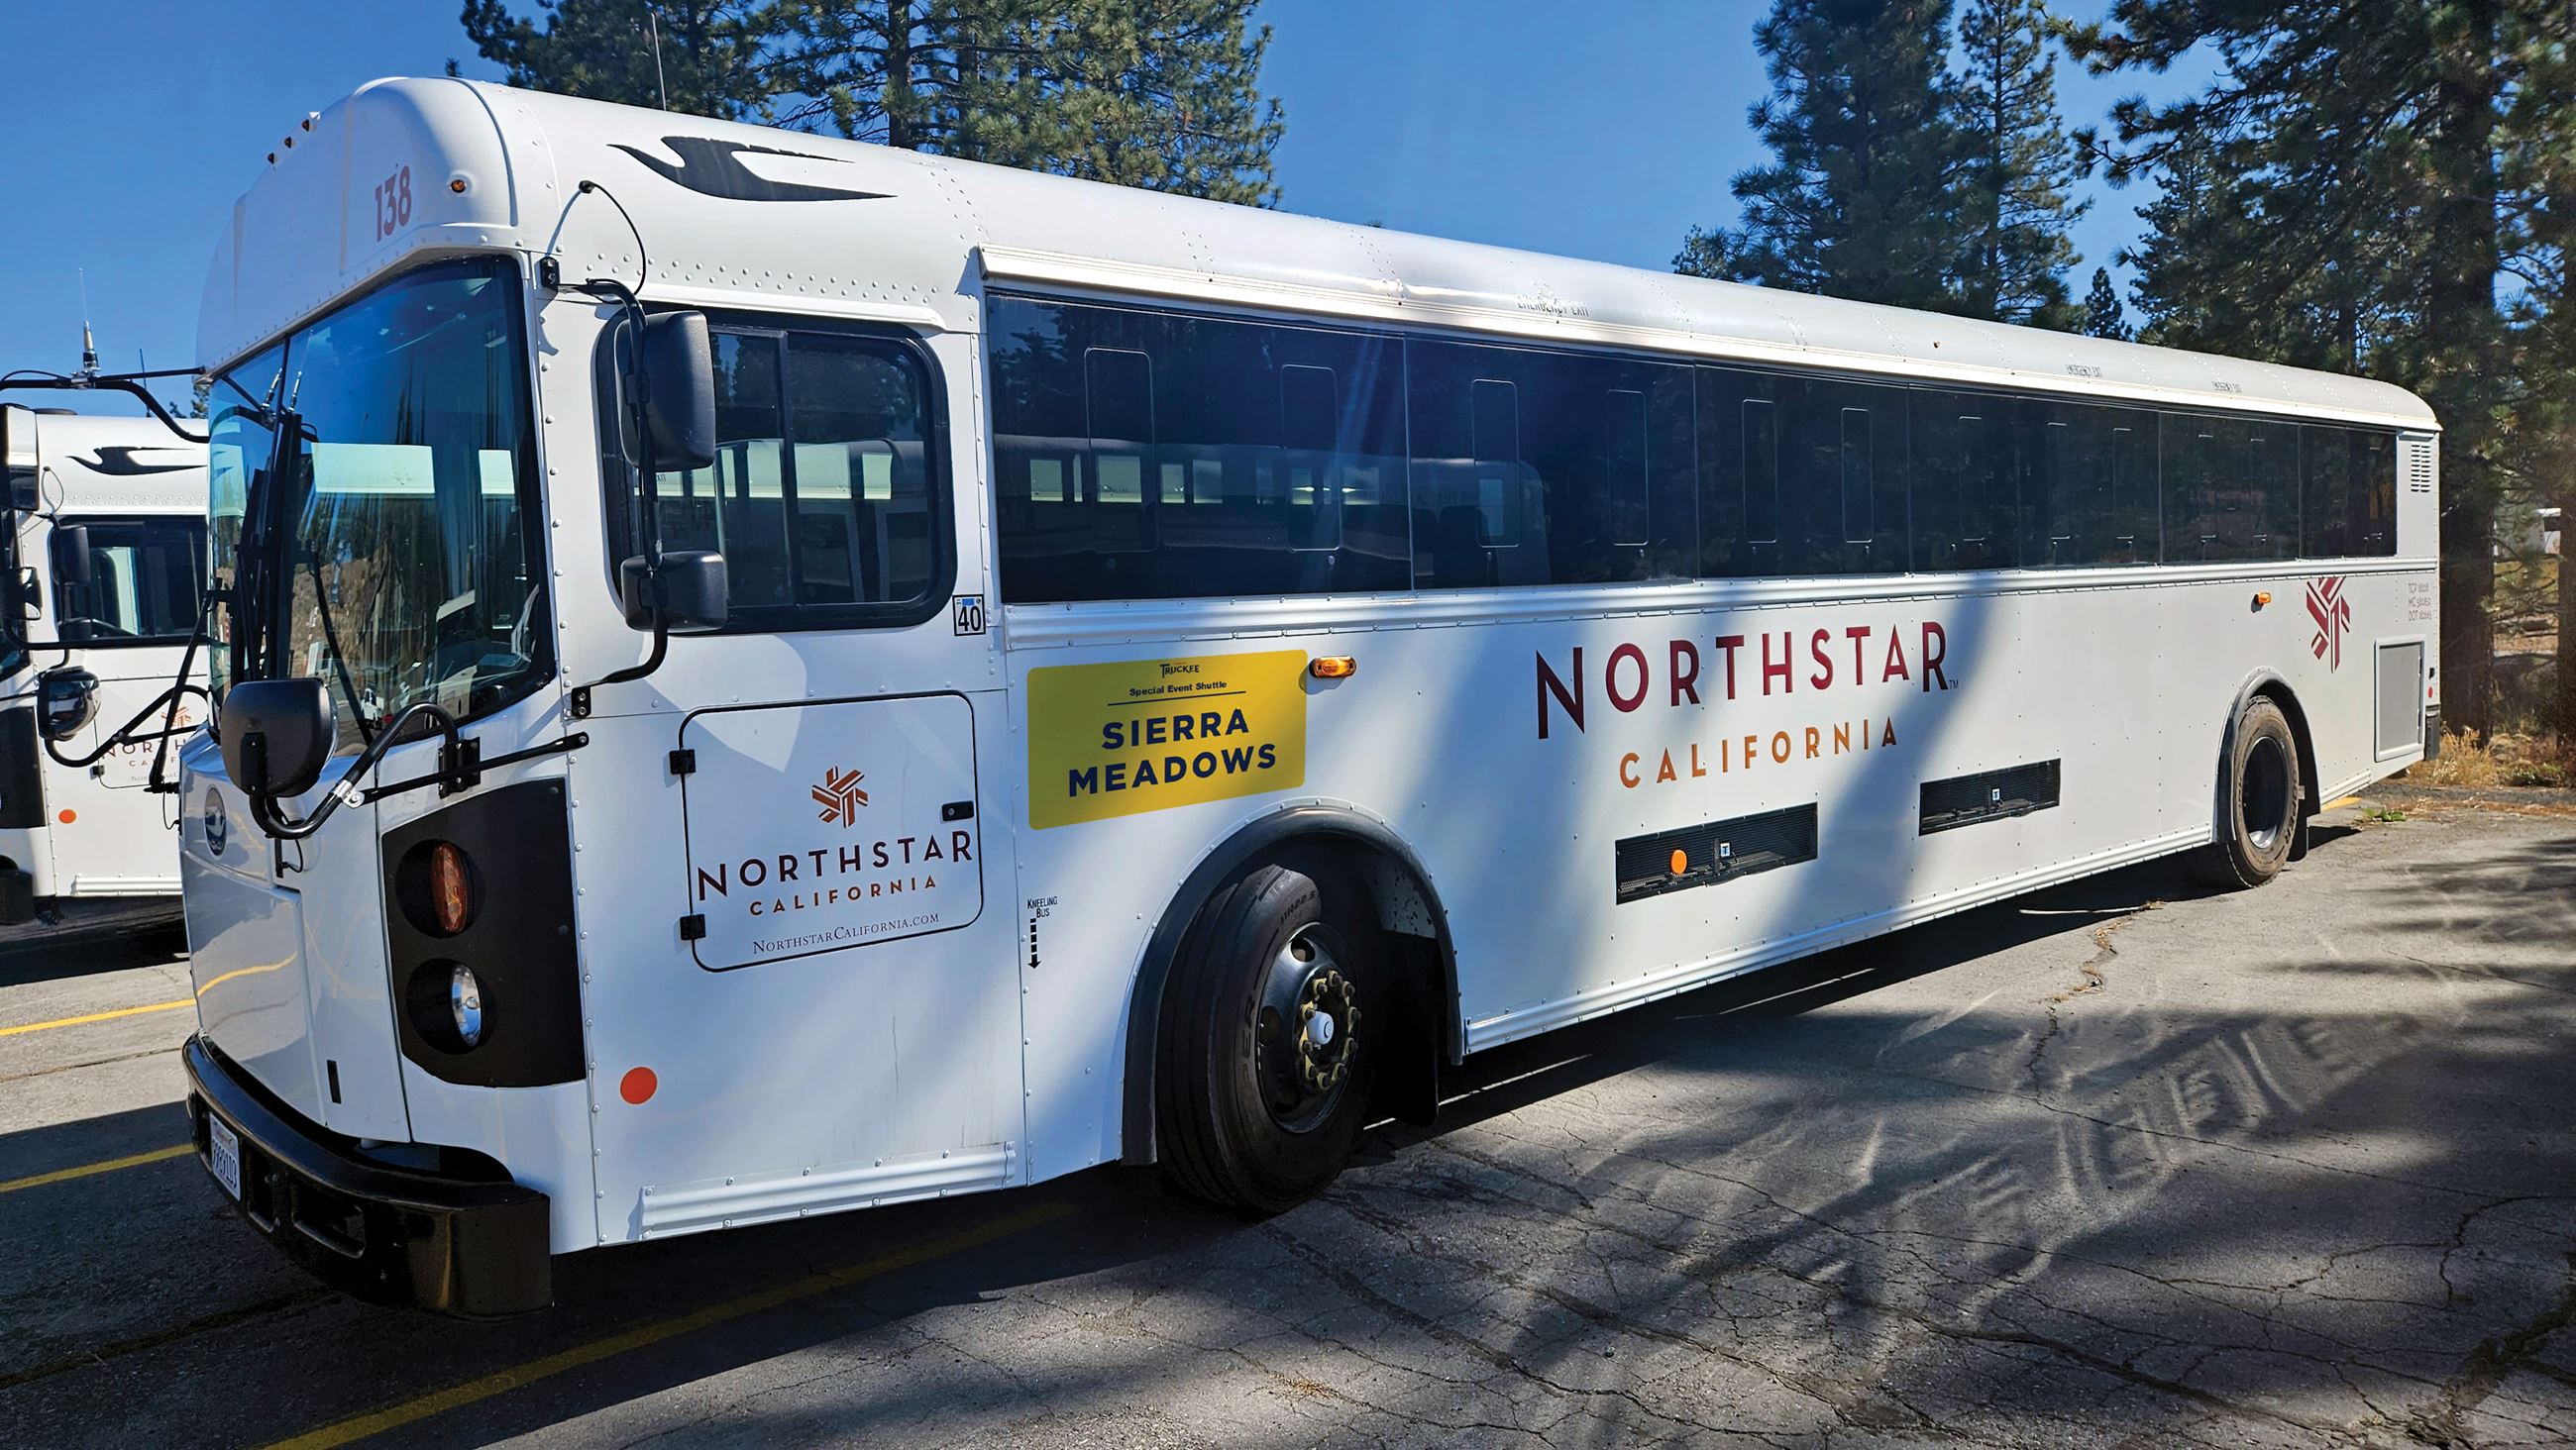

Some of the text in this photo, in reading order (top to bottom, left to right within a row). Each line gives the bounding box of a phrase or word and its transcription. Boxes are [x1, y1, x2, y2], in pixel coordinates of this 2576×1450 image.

[376, 165, 411, 242] 138
[958, 605, 981, 632] 40
[1129, 681, 1228, 696] Special Event Shuttle
[1536, 621, 1949, 740] NORTHSTAR
[1102, 707, 1249, 750] SIERRA
[1619, 716, 1897, 788] CALIFORNIA
[1069, 743, 1276, 797] MEADOWS
[698, 830, 973, 901] NORTHSTAR
[749, 875, 936, 916] CALIFORNIA
